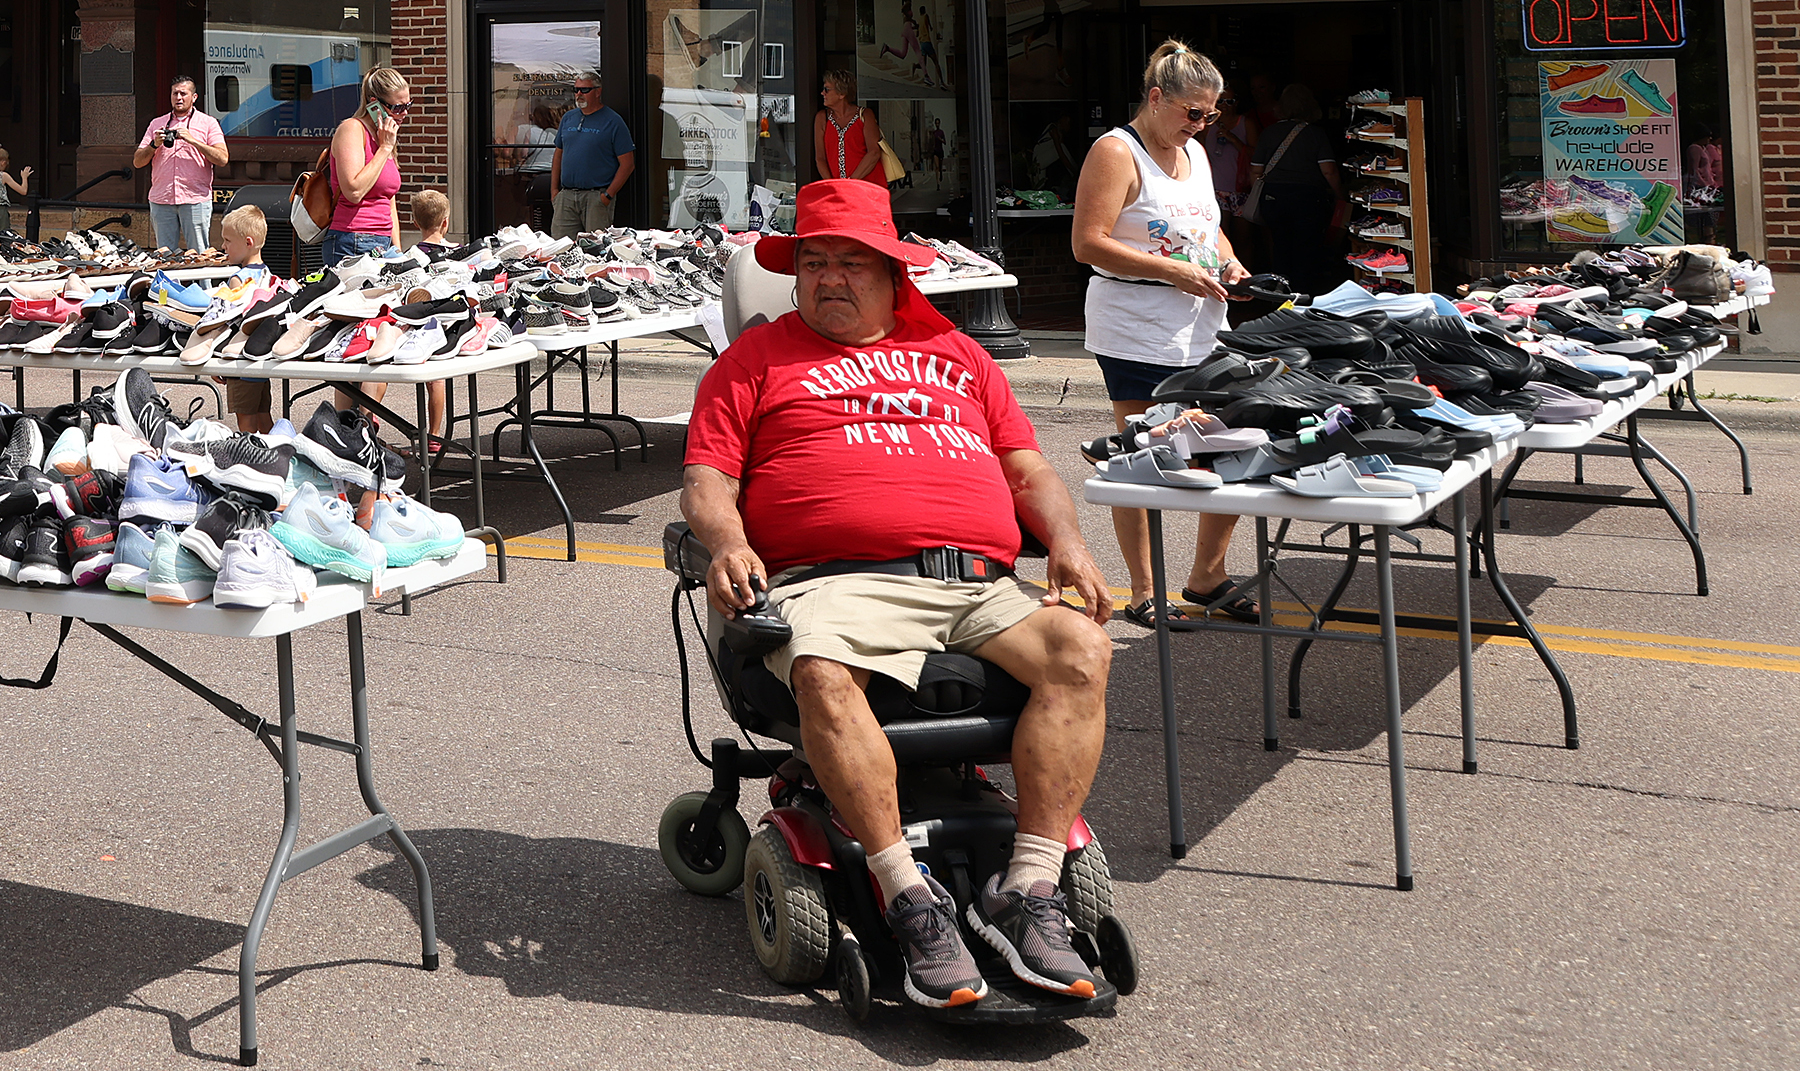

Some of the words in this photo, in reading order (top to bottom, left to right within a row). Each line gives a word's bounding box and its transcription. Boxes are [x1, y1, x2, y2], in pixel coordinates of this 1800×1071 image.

[528, 88, 565, 96] DENTIST
[567, 126, 600, 135] cahartt
[679, 127, 737, 139] BIRKENSTOCK
[1549, 121, 1611, 137] Brown's
[1612, 124, 1650, 135] SHOE
[1652, 124, 1672, 135] FIT
[1555, 158, 1668, 172] WAREHOUSE
[684, 187, 728, 201] Brown's
[1165, 204, 1186, 217] The
[1186, 201, 1213, 221] Big
[844, 399, 860, 414] 19
[943, 404, 960, 423] 87
[843, 422, 911, 445] NEW
[919, 423, 994, 458] YORK
[885, 446, 926, 456] REG.
